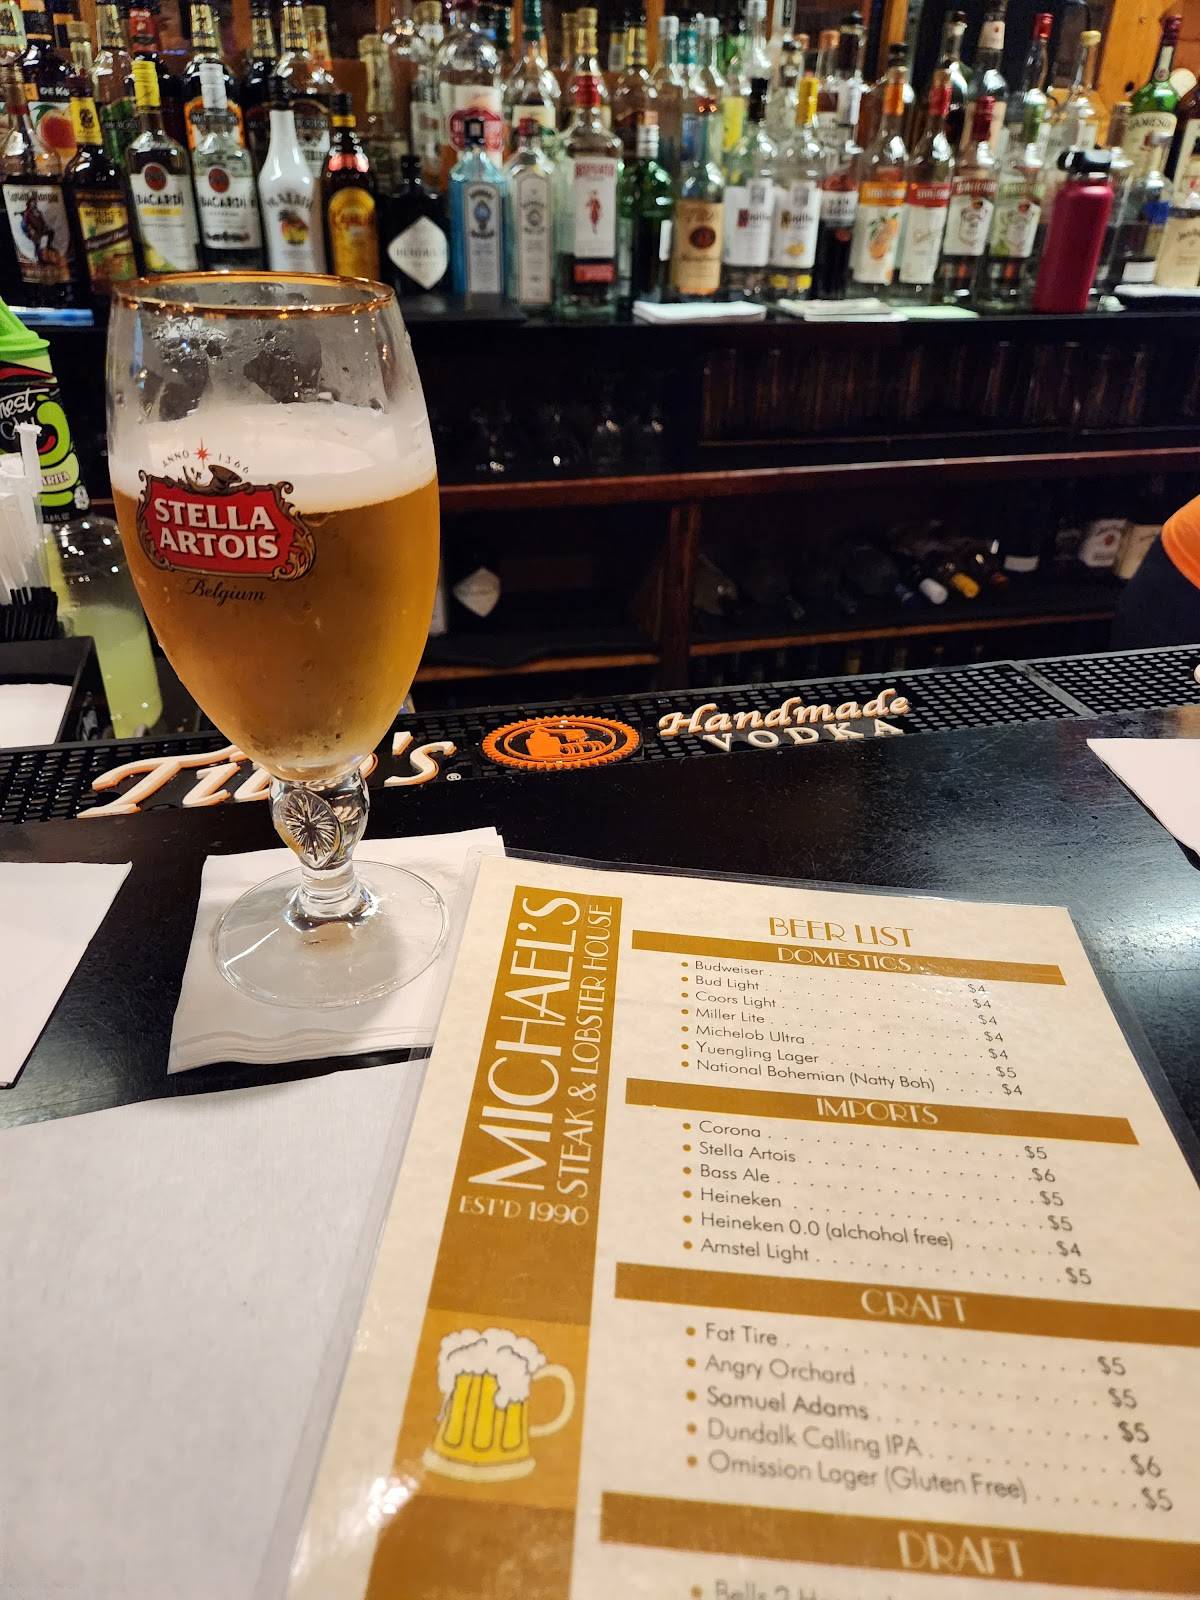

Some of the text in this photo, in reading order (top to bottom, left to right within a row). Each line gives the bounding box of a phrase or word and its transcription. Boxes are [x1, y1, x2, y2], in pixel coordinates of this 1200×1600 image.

[0, 387, 49, 419] nest
[42, 471, 71, 487] ARITA
[217, 452, 249, 475] 1366
[154, 498, 276, 532] STELLA
[159, 528, 279, 560] ARTOIS
[184, 577, 267, 606] Belgium
[658, 688, 910, 736] Handmade
[703, 718, 904, 752] VODKA
[769, 917, 913, 948] BEER LIST
[696, 961, 987, 994] Budweiser $4
[777, 947, 913, 974] DOMESTICS
[696, 975, 992, 1009] Bud Light $4
[696, 991, 998, 1026] Coors Light $4
[468, 896, 581, 1191] MICHAEL'S
[696, 1008, 1004, 1043] Miller Lite $4
[696, 1025, 1008, 1061] Michelob Ultra $4
[556, 904, 613, 1199] STEAK & LOBSTER HOUSE
[696, 1041, 1017, 1079] Yuengling Lager $5
[697, 1059, 1023, 1097] National Bohemian (Natty Boh) $4
[817, 1098, 939, 1125] IMPORTS
[699, 1121, 1048, 1160] Corona $5
[699, 1141, 1056, 1183] Stella Artois $6
[701, 1164, 1065, 1207] Bass Ale $5
[459, 1195, 589, 1226] EST'D 1990
[701, 1187, 1073, 1233] Heineken $5
[702, 1212, 1082, 1258] Heineken 0.0 (alchohol free) $4
[701, 1238, 1093, 1286] Amstel Light $5
[861, 1291, 966, 1323] CRAFT
[706, 1322, 1127, 1377] Fat Tire $5
[705, 1354, 1138, 1410] Angry Orchard $5
[707, 1385, 1150, 1444] Samuel Adams $5
[708, 1417, 1162, 1479] Dundalk Calling IPA $6
[708, 1449, 1174, 1512] Omission Lager (Gluten Free) $5
[898, 1530, 1024, 1578] DRAFT
